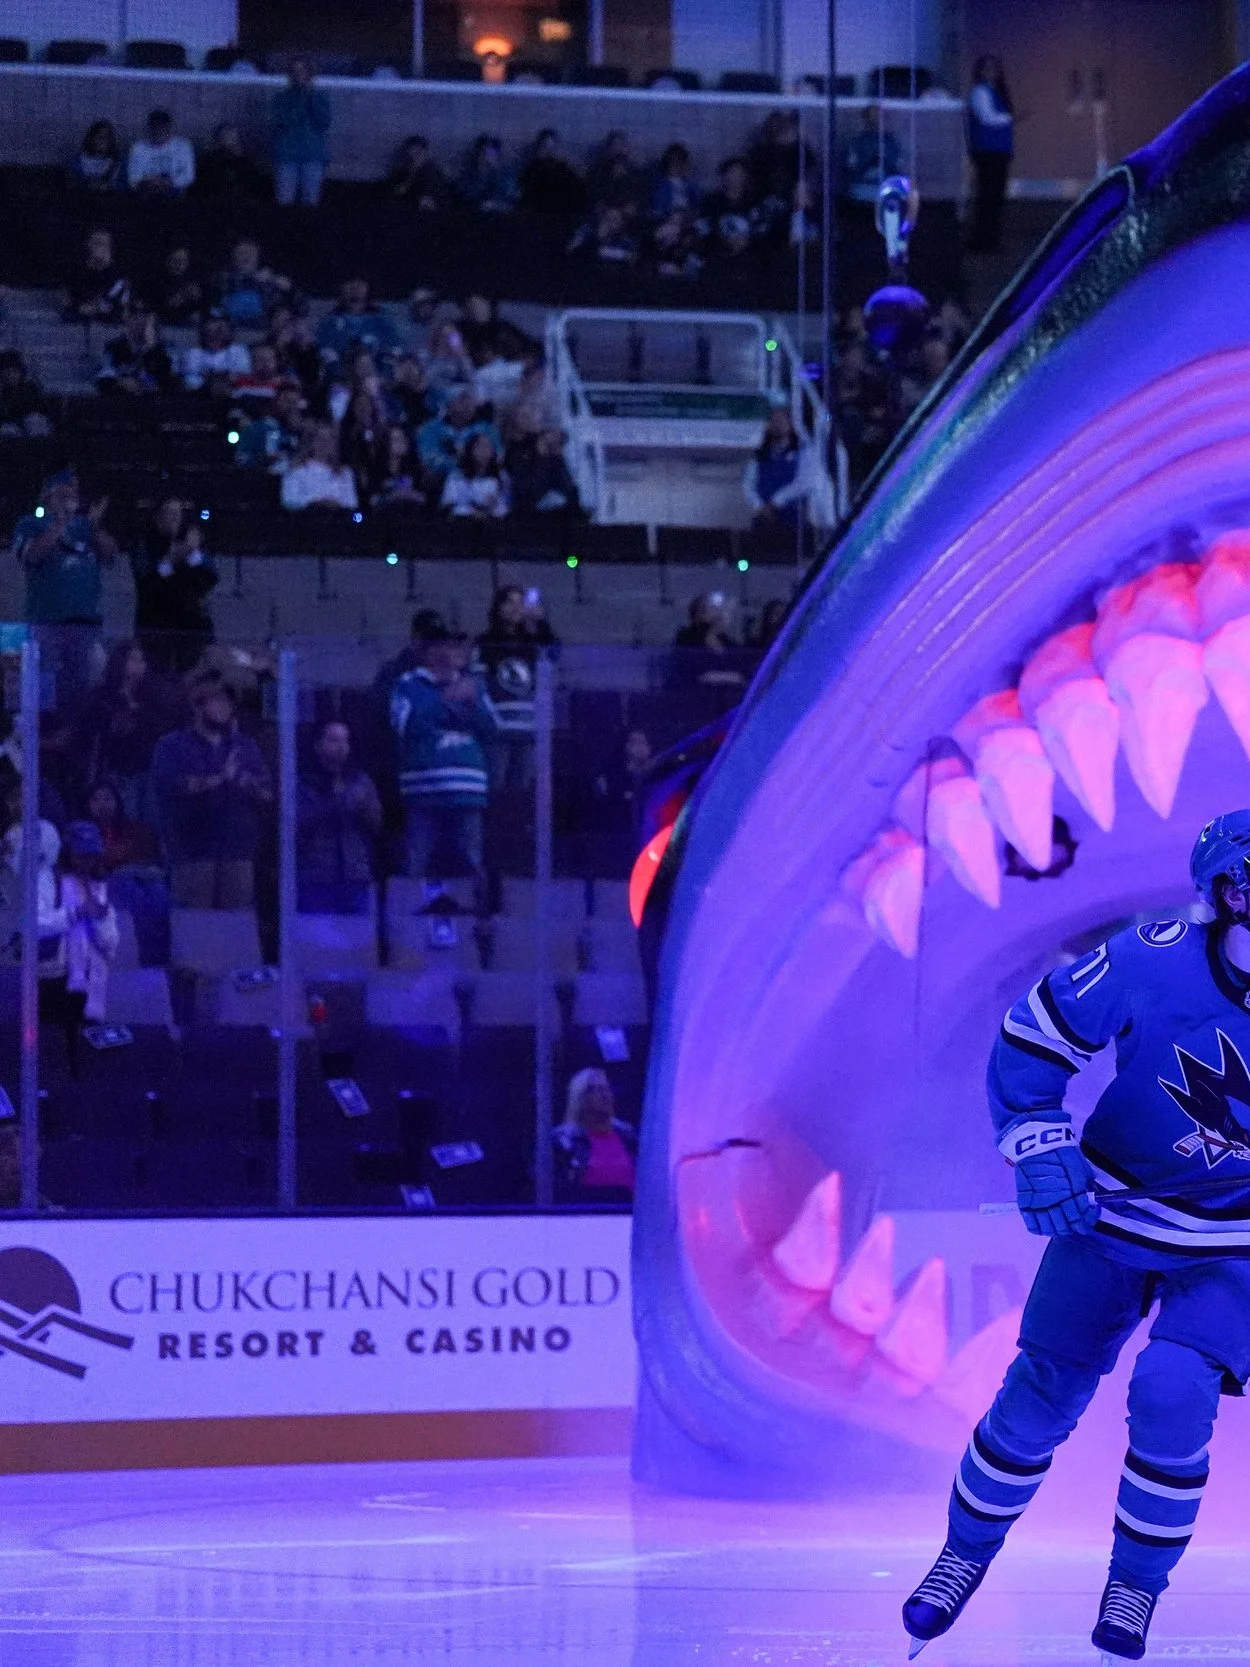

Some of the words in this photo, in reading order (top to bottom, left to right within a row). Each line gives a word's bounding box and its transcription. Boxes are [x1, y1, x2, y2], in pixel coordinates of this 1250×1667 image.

[1071, 942, 1110, 999] 71
[109, 1267, 456, 1315] CHUKCHANSI
[473, 1265, 621, 1309] GOLD
[157, 1331, 325, 1360] RESORT
[350, 1329, 377, 1355] &
[405, 1325, 572, 1355] CASINO
